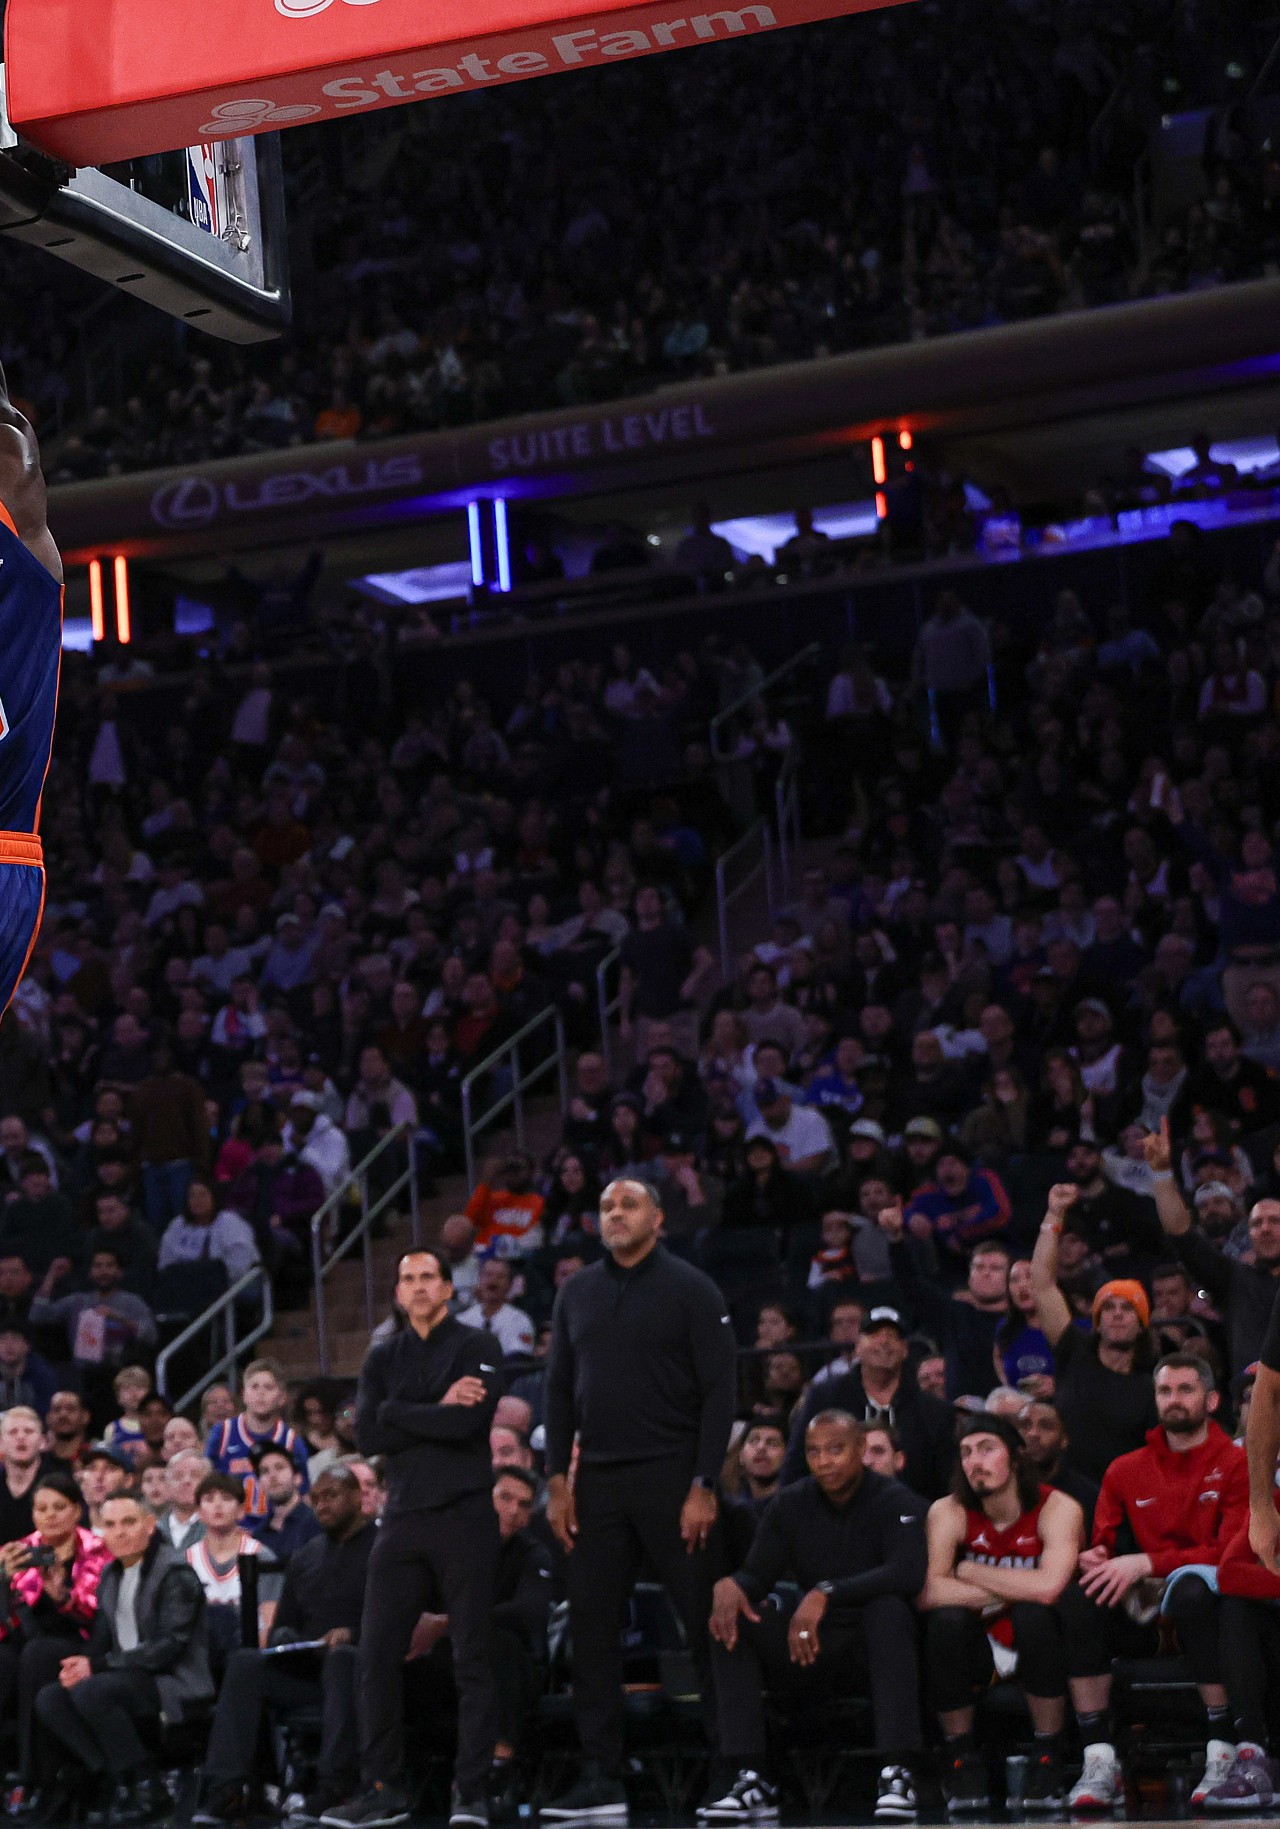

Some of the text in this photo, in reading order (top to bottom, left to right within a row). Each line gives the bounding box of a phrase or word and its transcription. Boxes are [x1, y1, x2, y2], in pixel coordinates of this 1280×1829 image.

[192, 196, 209, 227] NBA
[488, 404, 714, 473] SUITE LEVEL
[225, 453, 423, 512] LEXUS
